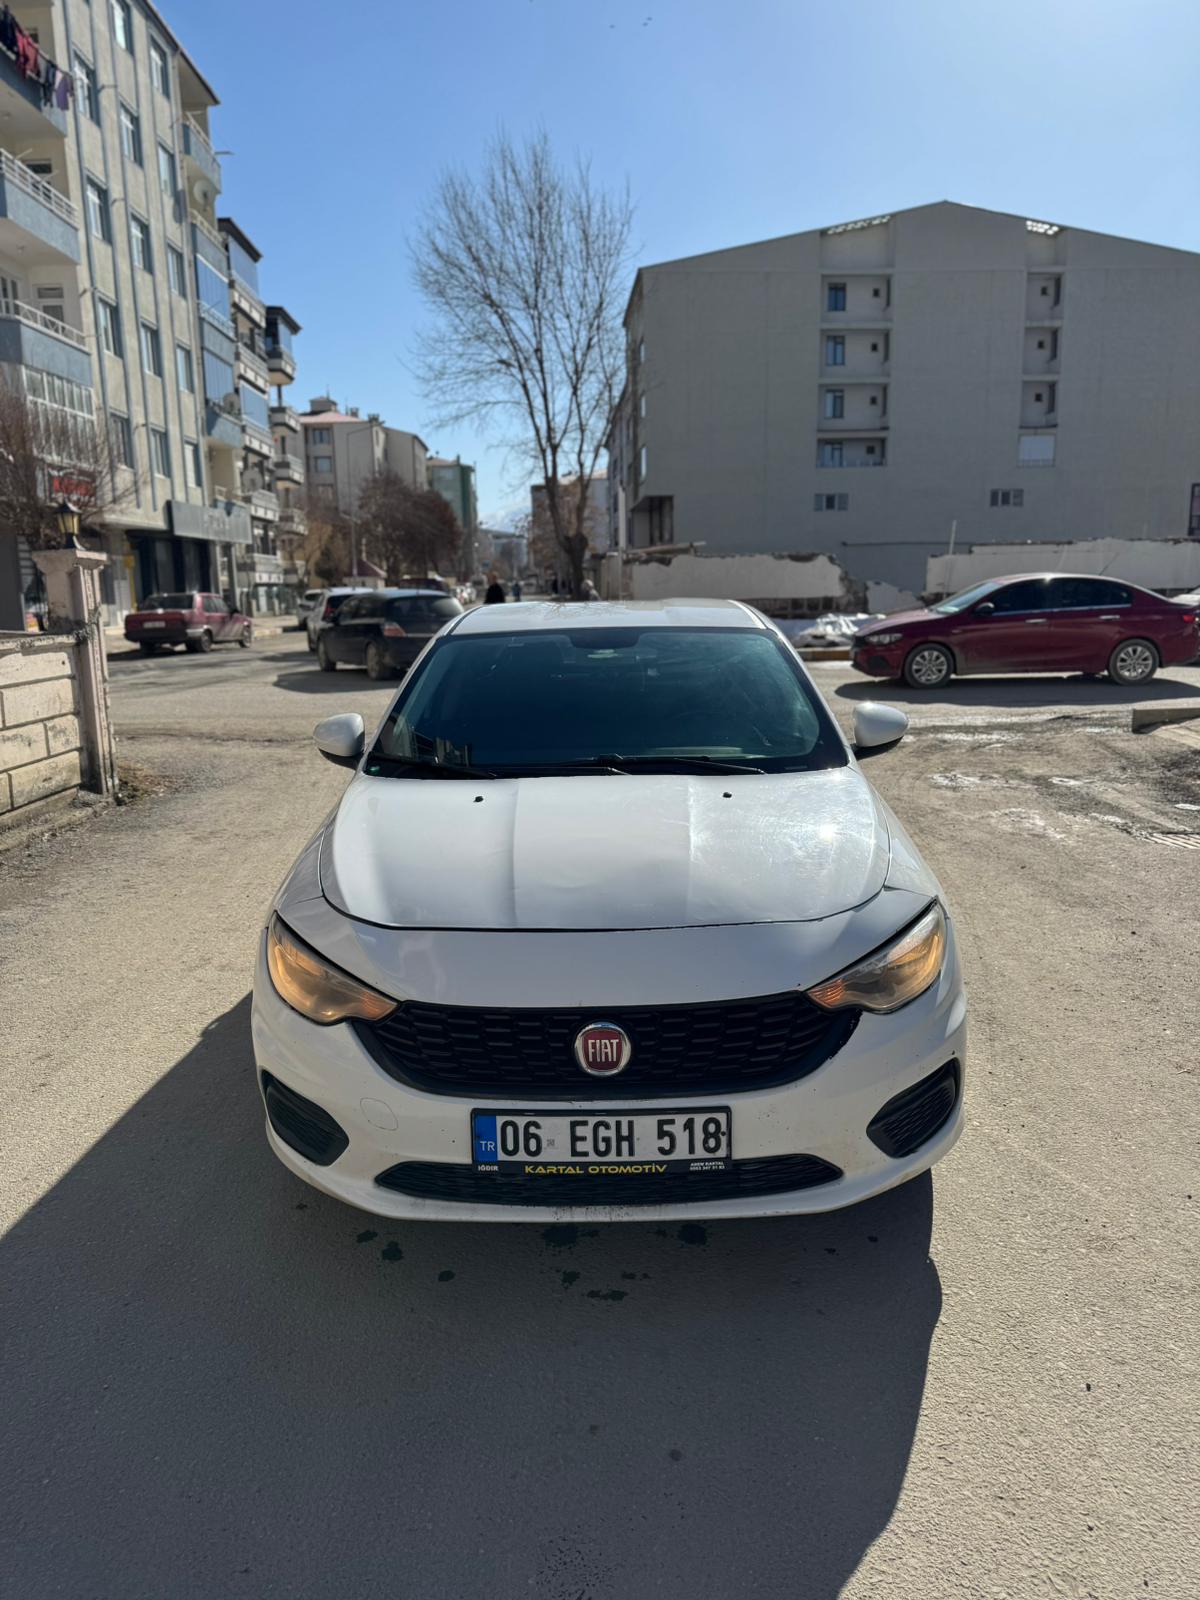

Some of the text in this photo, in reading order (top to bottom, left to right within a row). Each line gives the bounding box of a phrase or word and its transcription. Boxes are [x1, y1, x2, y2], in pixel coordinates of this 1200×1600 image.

[588, 1039, 619, 1062] FIAT
[480, 1117, 722, 1157] TR 06 EGH 518
[525, 1163, 668, 1174] KARTAL OTOMOTİV
